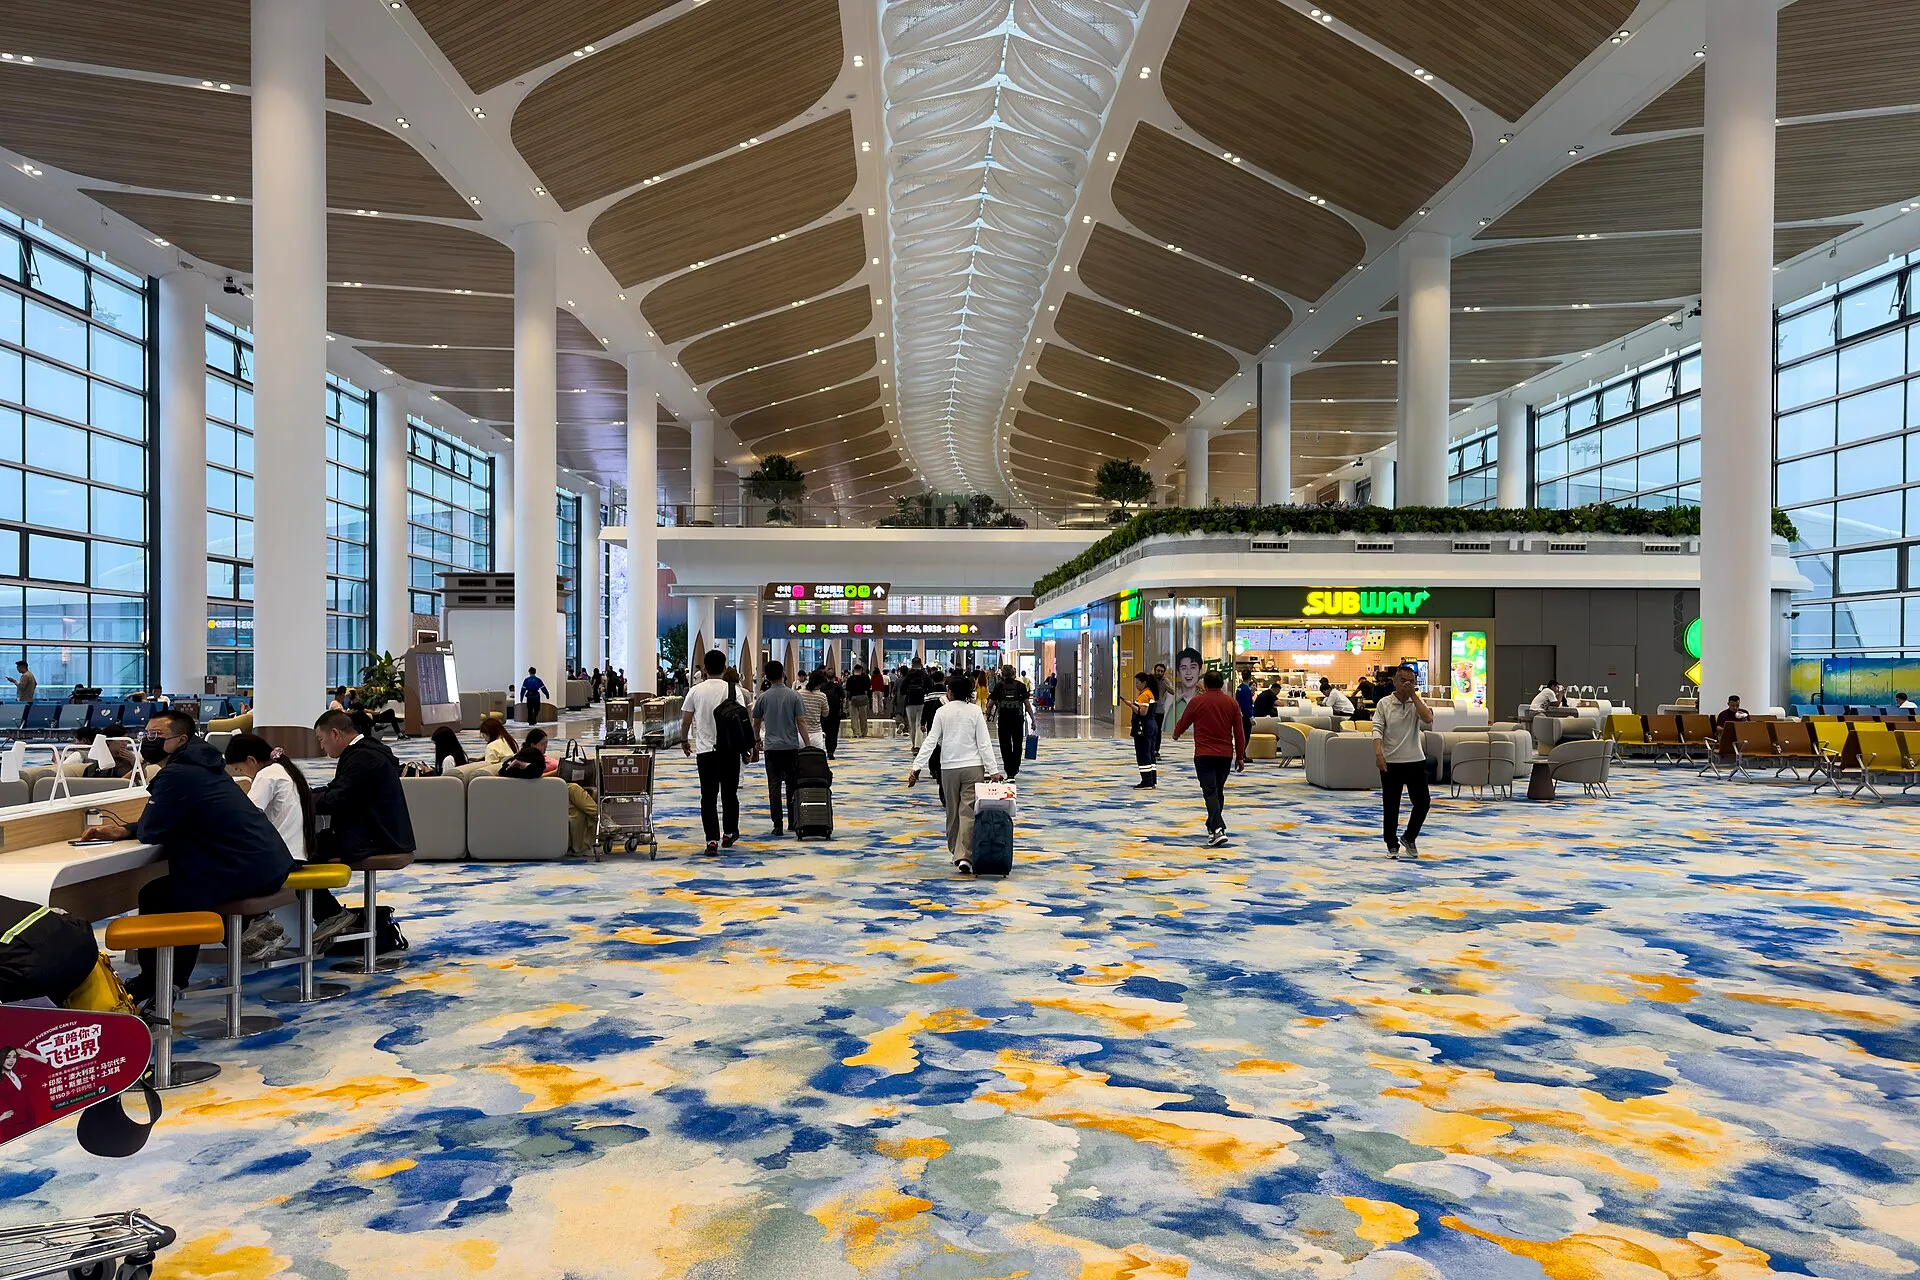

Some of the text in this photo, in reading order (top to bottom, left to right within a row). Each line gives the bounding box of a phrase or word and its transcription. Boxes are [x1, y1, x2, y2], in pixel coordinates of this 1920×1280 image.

[1302, 590, 1431, 616] SUBWAY
[24, 1038, 36, 1048] NOW
[35, 1026, 59, 1040] EVERYONE
[41, 1028, 90, 1047] 一直陪你
[45, 1039, 97, 1064] 飞世界
